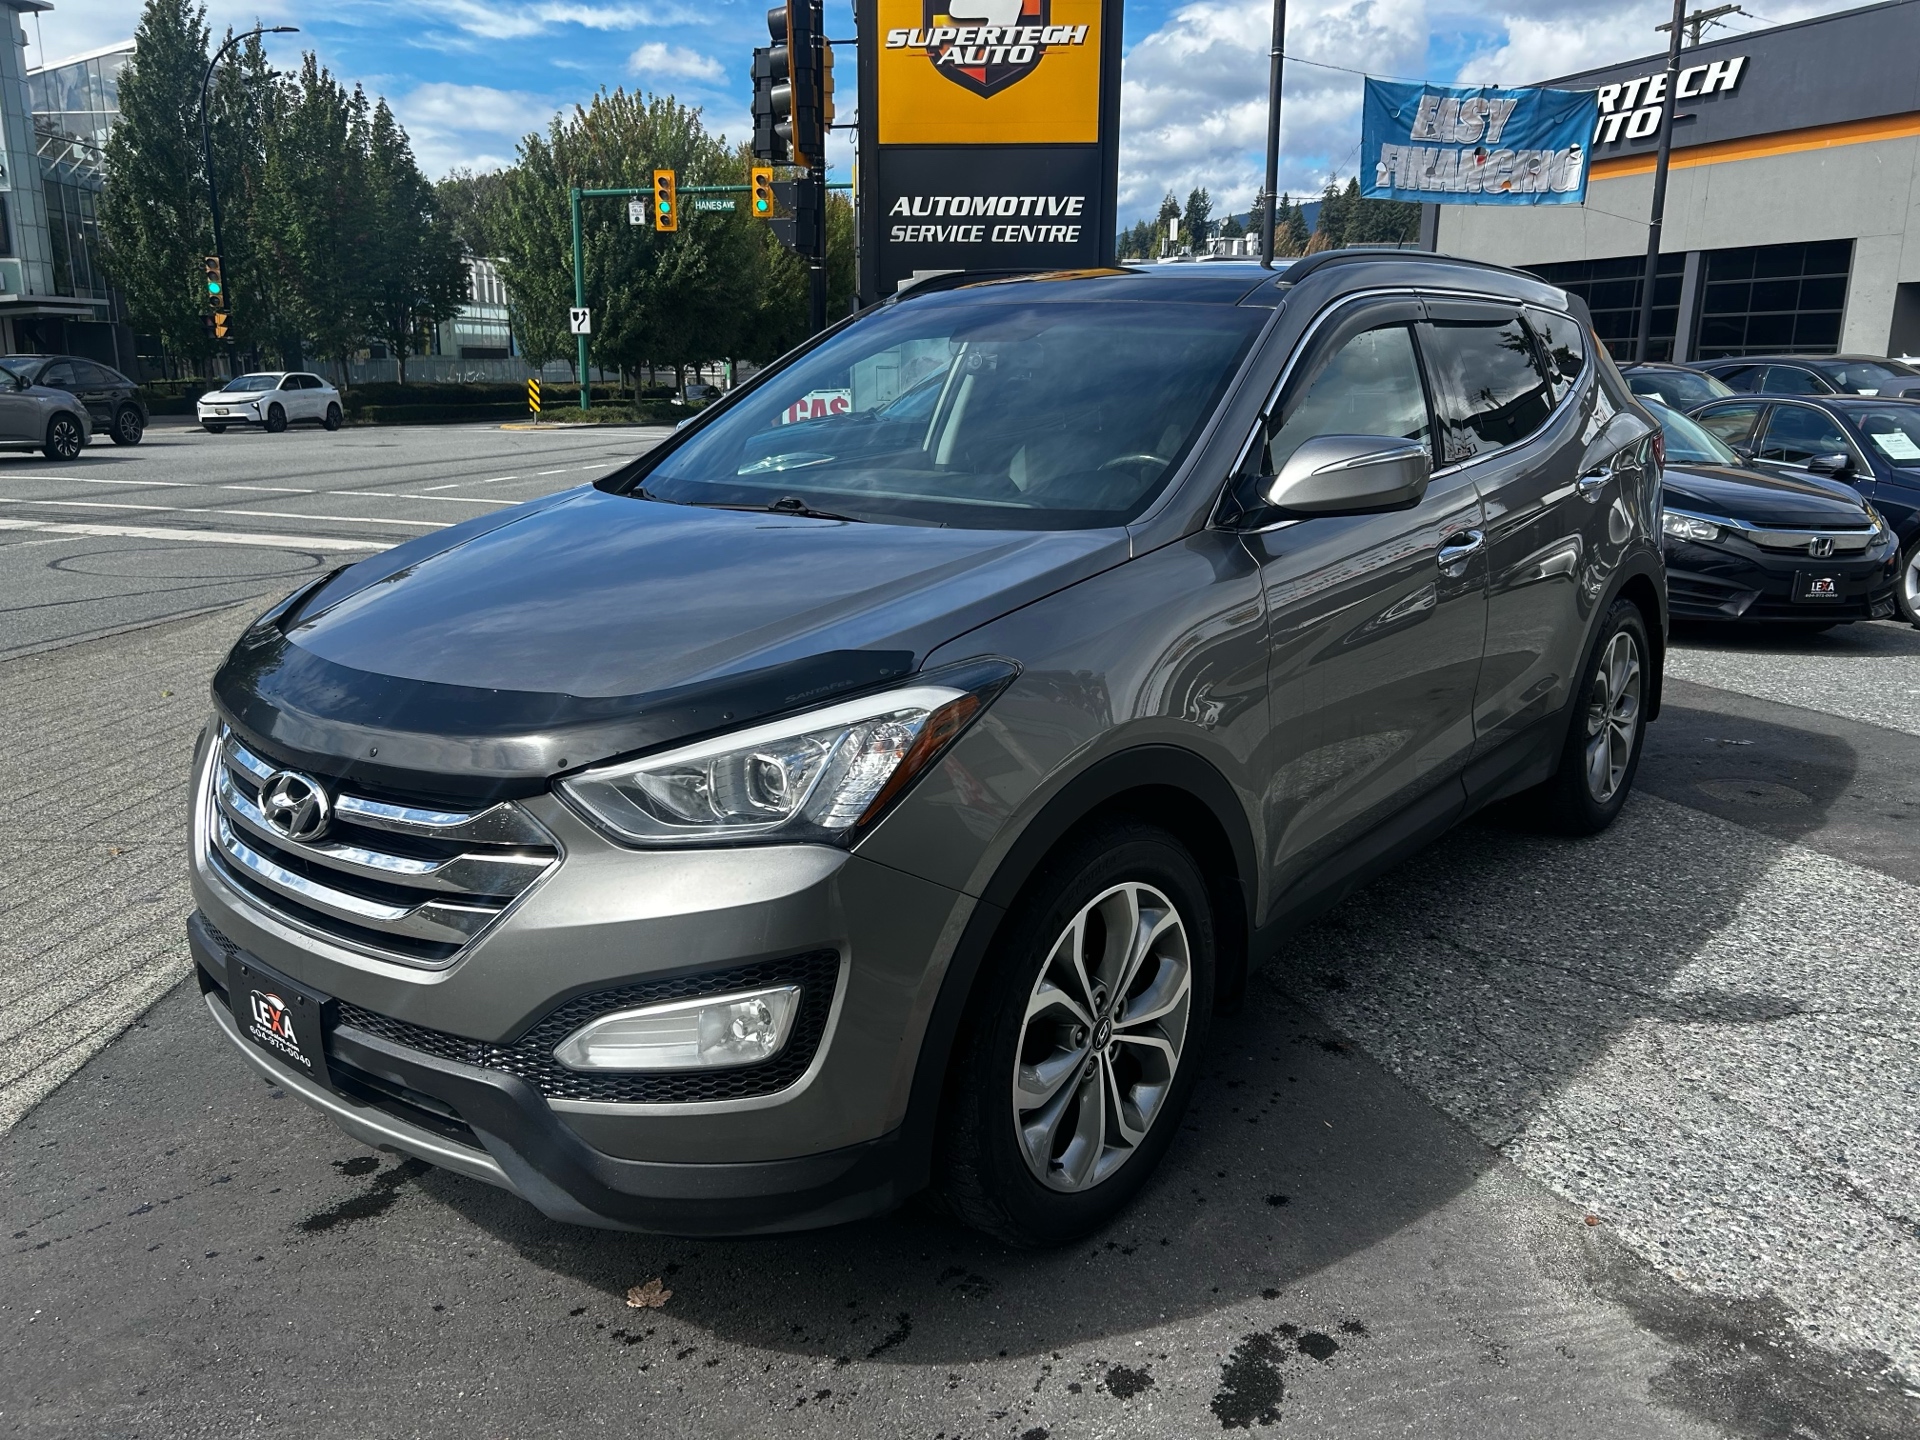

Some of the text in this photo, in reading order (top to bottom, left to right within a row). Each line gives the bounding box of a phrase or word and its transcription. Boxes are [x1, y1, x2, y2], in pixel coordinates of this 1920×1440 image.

[885, 25, 1090, 48] SUPERTECH
[936, 45, 1035, 65] AUTO
[1410, 94, 1518, 144] EASY
[1375, 143, 1584, 194] FINANCING
[695, 201, 722, 210] HANES
[889, 196, 1085, 217] AUTOMOTIVE
[890, 225, 1081, 243] SERVICE CENTRE
[1811, 582, 1834, 591] LEXA
[250, 995, 298, 1045] LEXA
